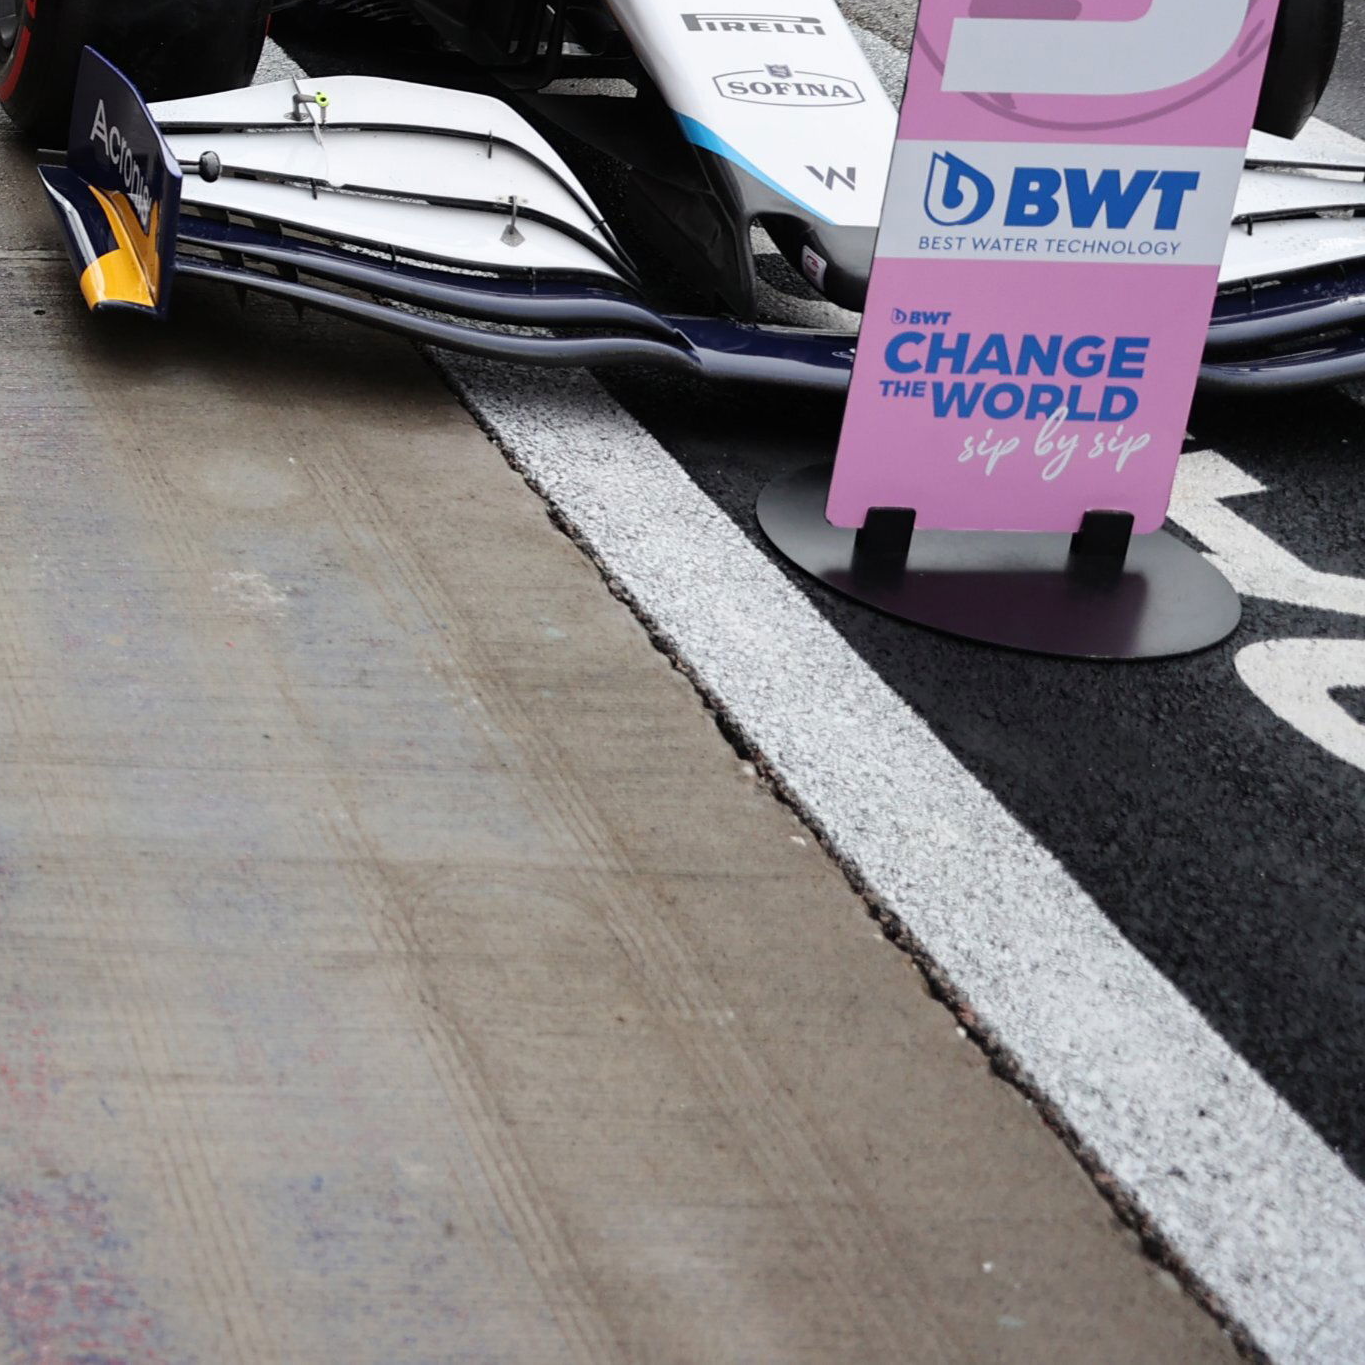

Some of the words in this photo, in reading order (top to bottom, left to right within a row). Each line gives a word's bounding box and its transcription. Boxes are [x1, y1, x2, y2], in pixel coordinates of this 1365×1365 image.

[680, 13, 826, 36] PIRELLI
[729, 79, 854, 100] SOFINA
[1004, 167, 1200, 231] BWT
[918, 236, 968, 252] BEST
[973, 237, 1040, 254] WATER
[1044, 238, 1182, 257] TECHNOLOGY
[908, 311, 952, 326] BWT
[883, 330, 1151, 379] CHANGE
[879, 380, 926, 399] THE
[930, 381, 1139, 423] WORLD
[958, 426, 1020, 482] sip
[1033, 405, 1079, 482] by
[1088, 426, 1152, 474] sip
